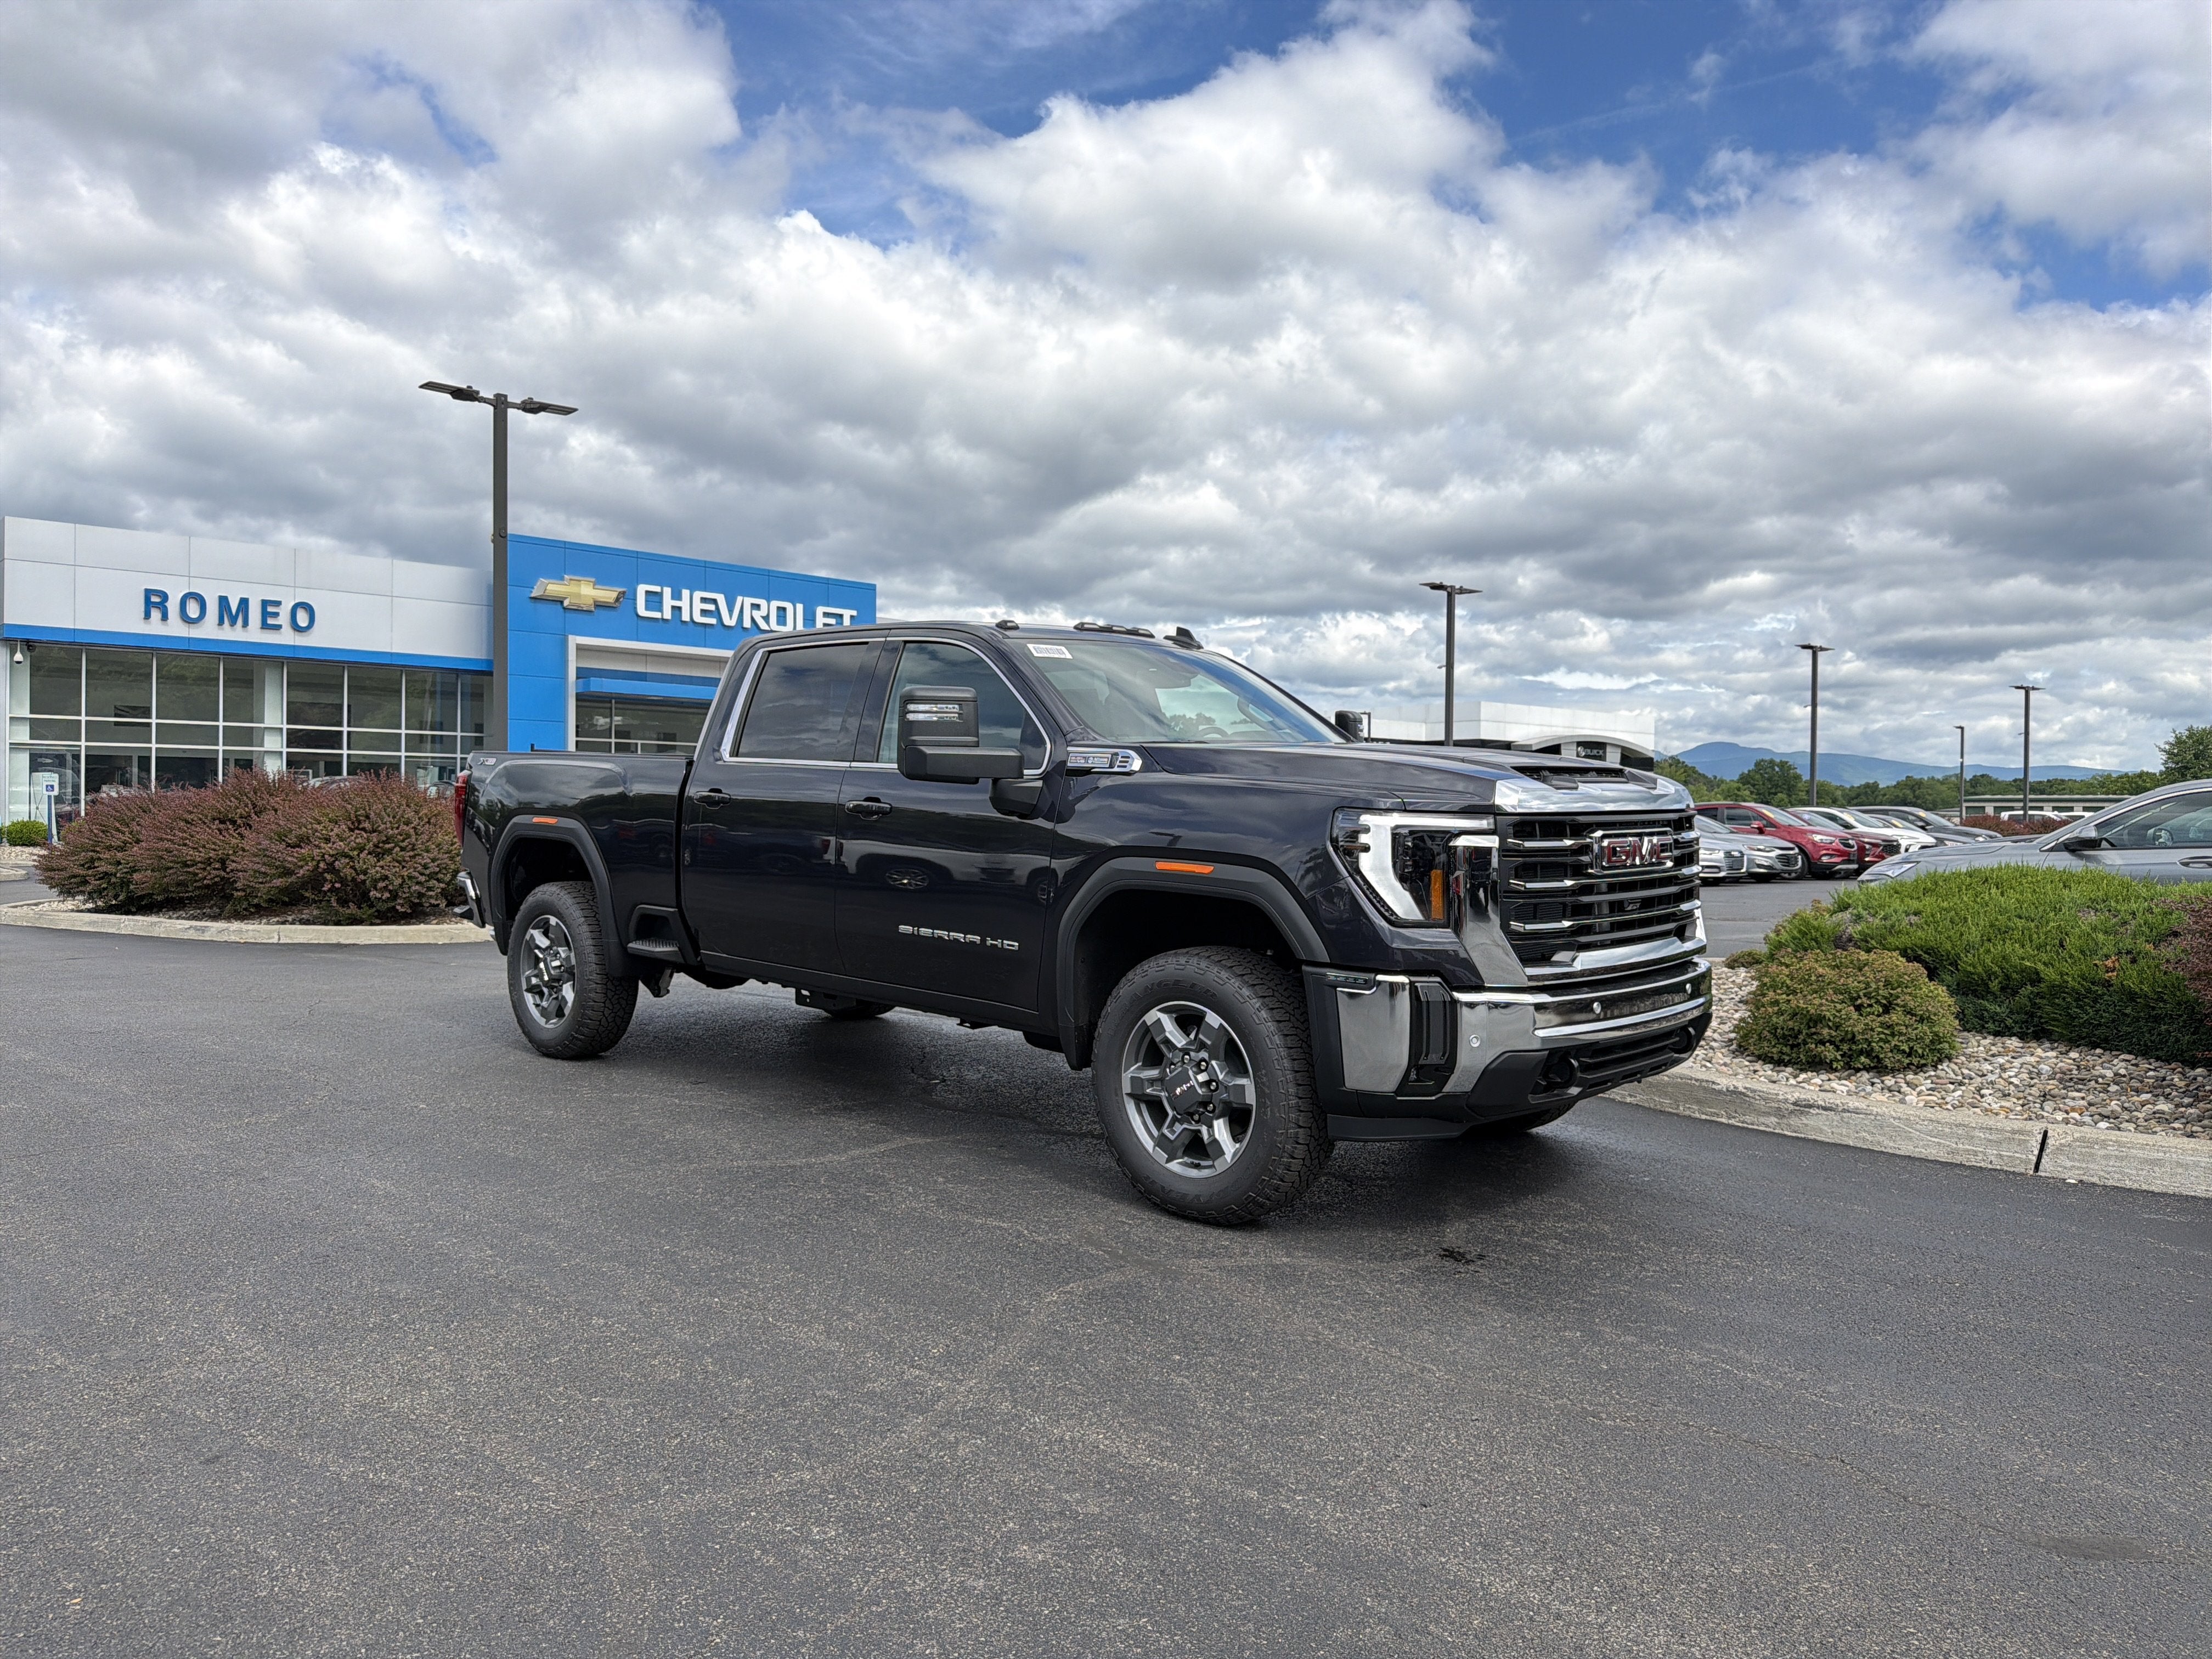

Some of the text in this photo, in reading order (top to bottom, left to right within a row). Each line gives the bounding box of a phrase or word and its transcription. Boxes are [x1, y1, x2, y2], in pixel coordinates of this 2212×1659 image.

[143, 588, 316, 633] ROMEO
[1601, 836, 1673, 867] GMC
[898, 925, 1019, 951] SIERRA HD
